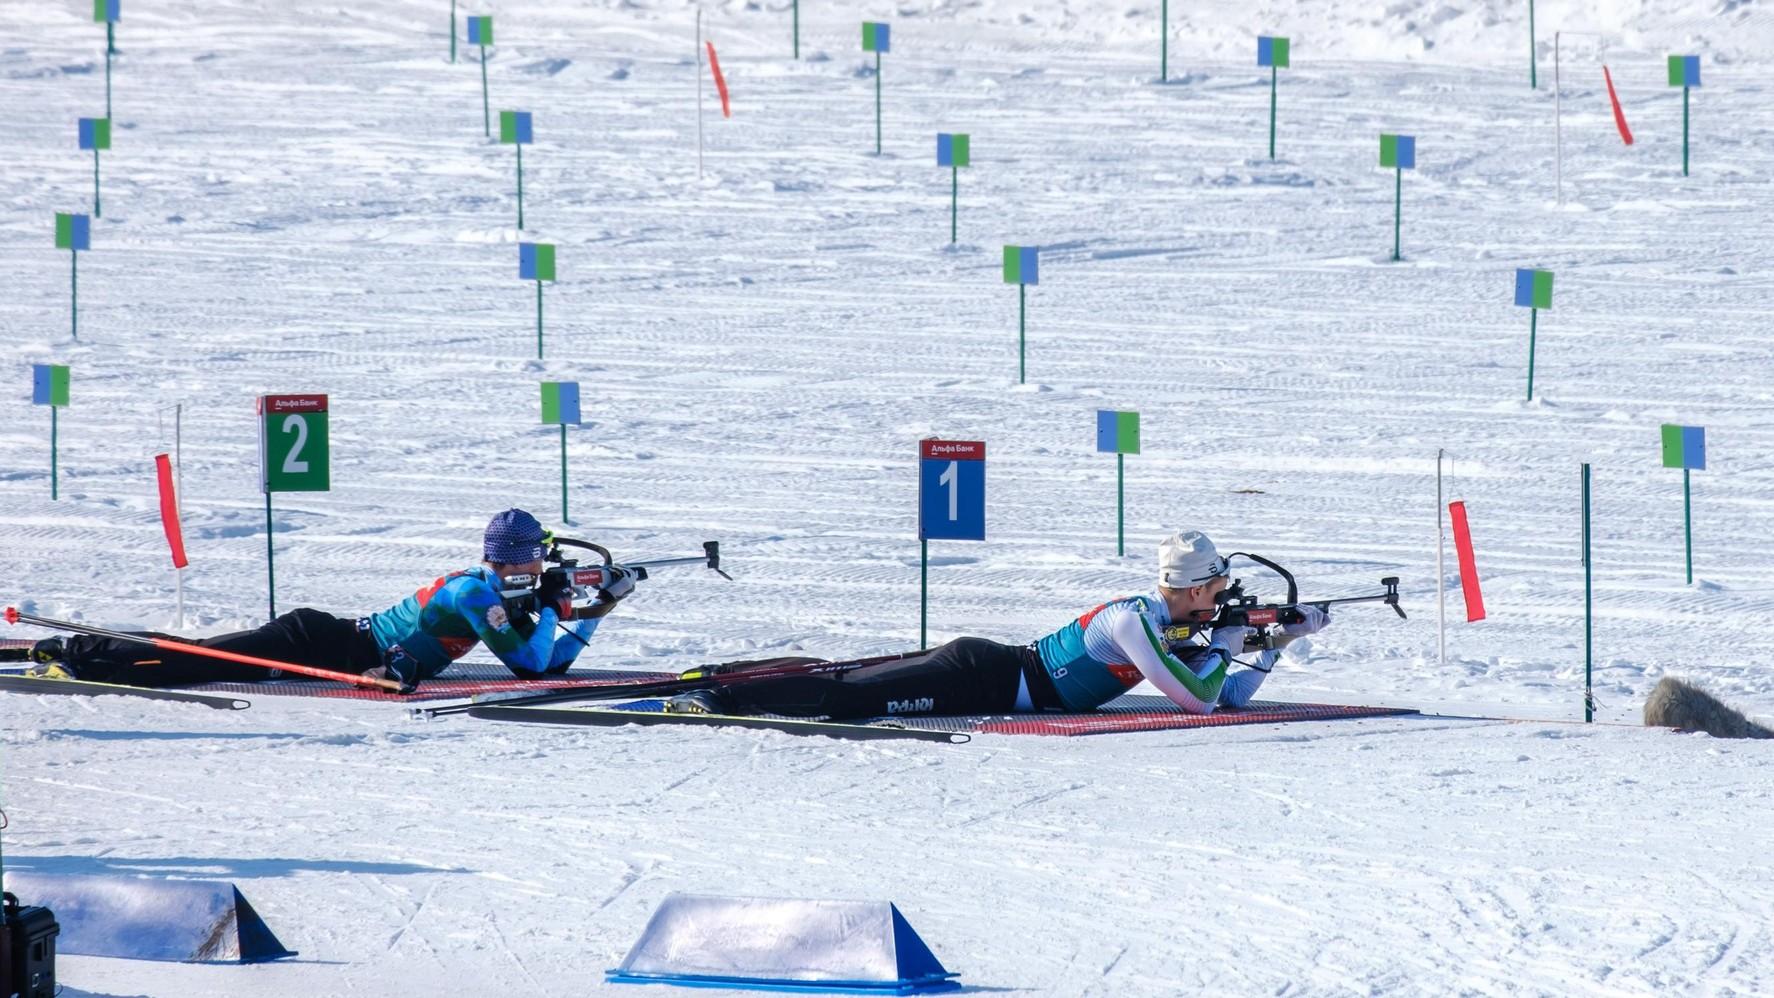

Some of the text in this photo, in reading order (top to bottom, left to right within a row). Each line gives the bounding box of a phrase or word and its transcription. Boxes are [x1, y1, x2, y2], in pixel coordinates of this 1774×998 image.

[275, 399, 299, 408] Альфа
[282, 414, 309, 473] 2
[931, 444, 975, 453] Альфа Банк
[939, 460, 958, 521] 1
